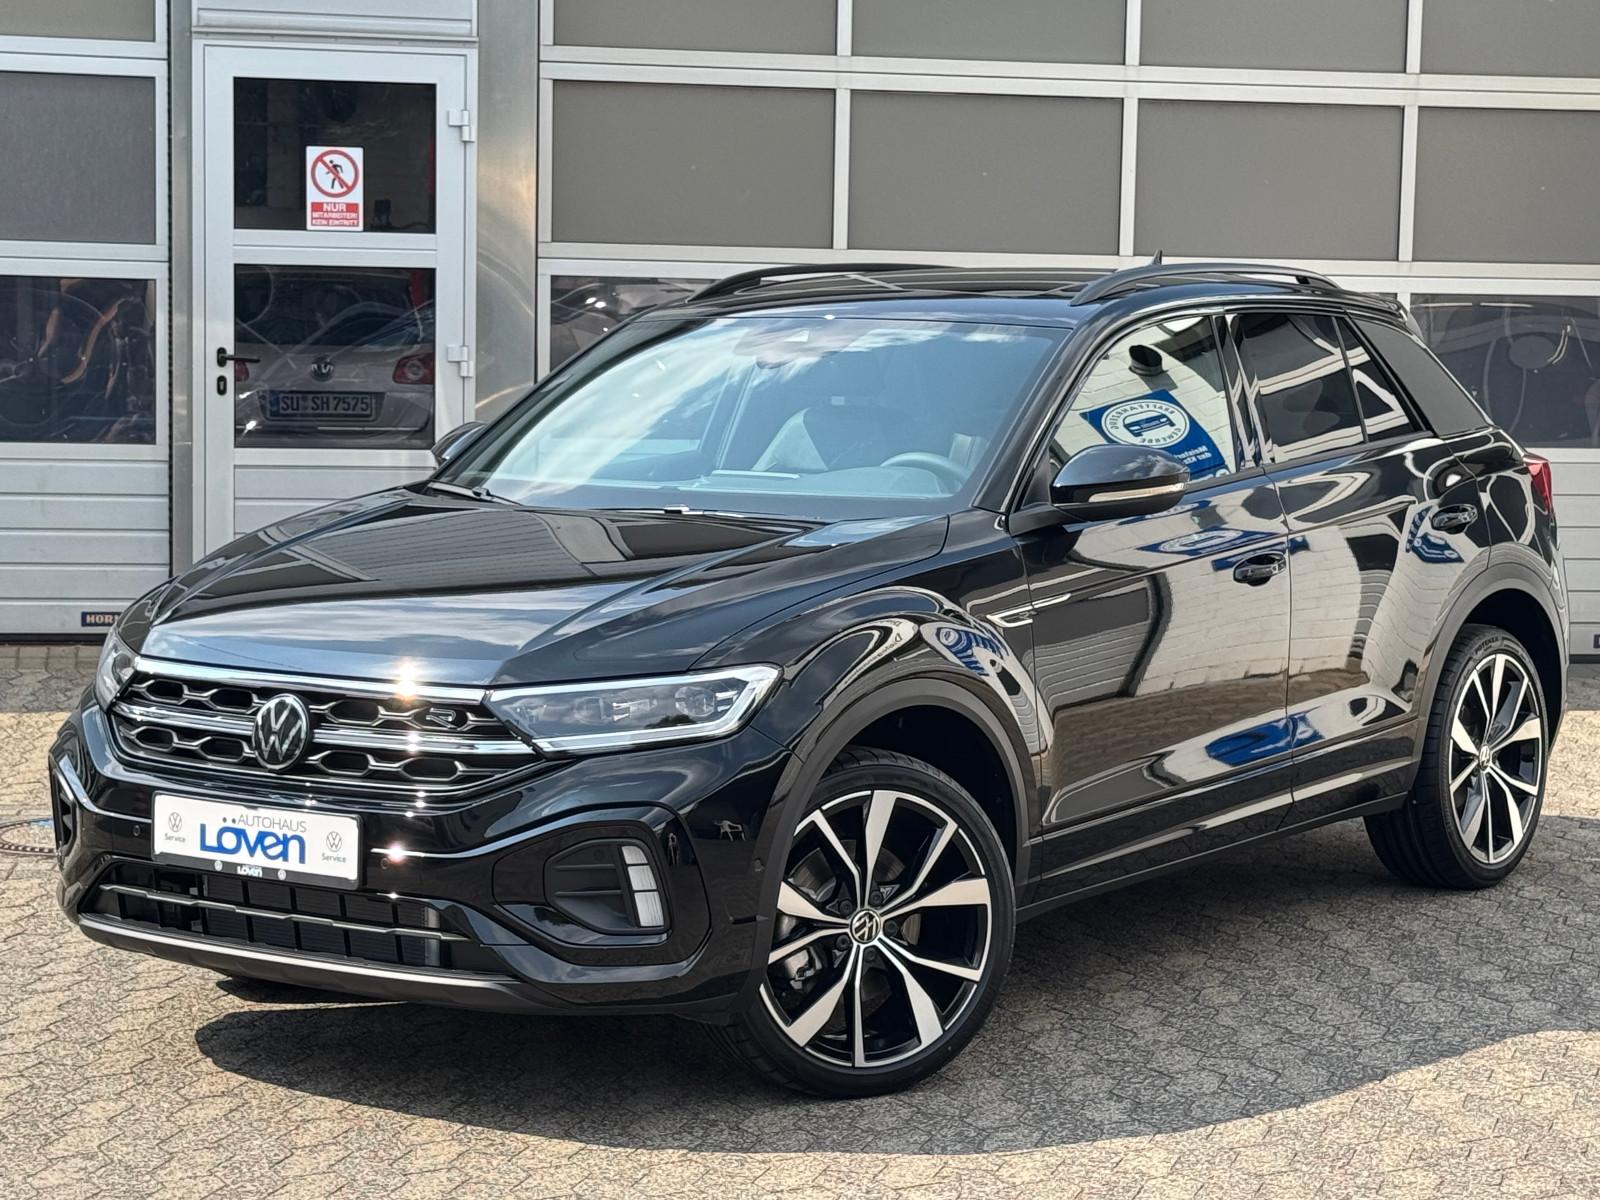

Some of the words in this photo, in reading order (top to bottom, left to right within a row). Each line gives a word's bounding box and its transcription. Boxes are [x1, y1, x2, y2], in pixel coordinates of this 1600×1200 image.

[323, 203, 346, 211] NUR
[281, 396, 299, 413] SU
[311, 396, 330, 412] SH
[334, 396, 370, 412] 7575
[238, 814, 307, 833] AUTOHAUS
